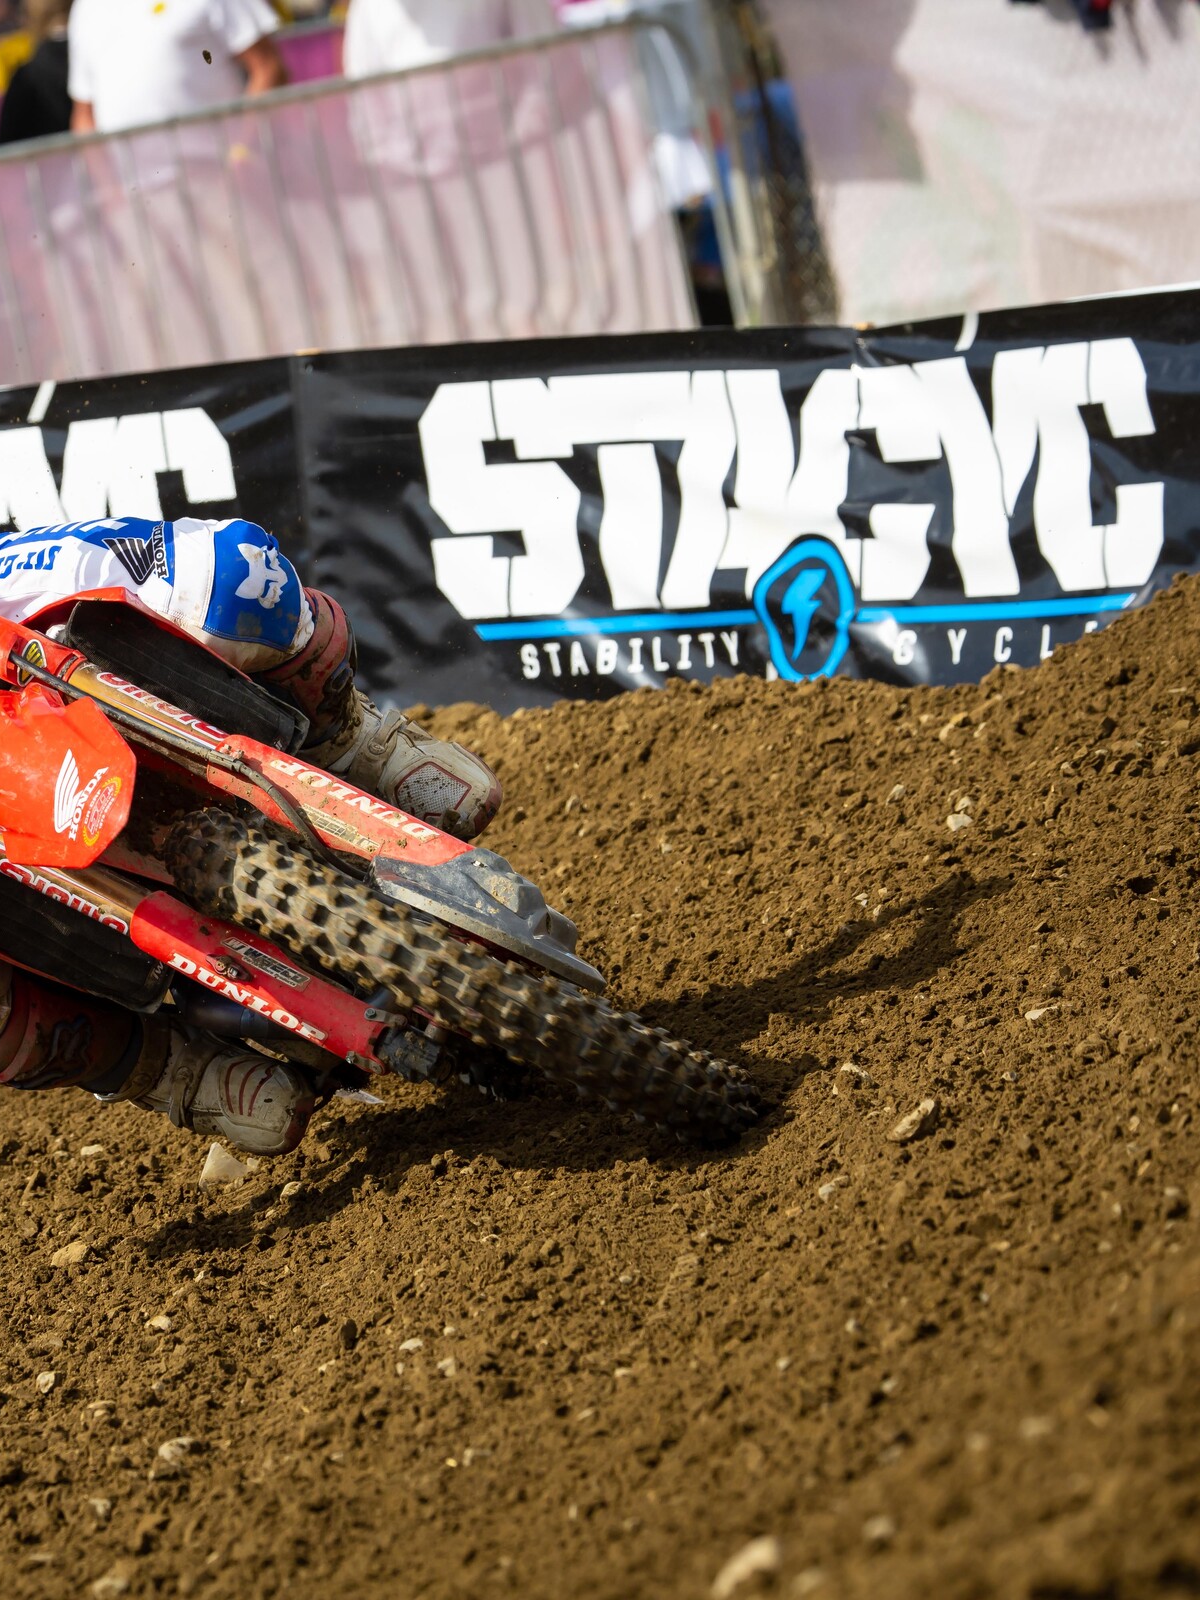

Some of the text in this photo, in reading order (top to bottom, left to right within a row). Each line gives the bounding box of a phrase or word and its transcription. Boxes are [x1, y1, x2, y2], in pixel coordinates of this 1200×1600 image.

[520, 631, 741, 681] STABILITY
[68, 767, 109, 842] HONDA
[270, 759, 440, 842] DUNLOP
[167, 952, 328, 1040] DUNLOP
